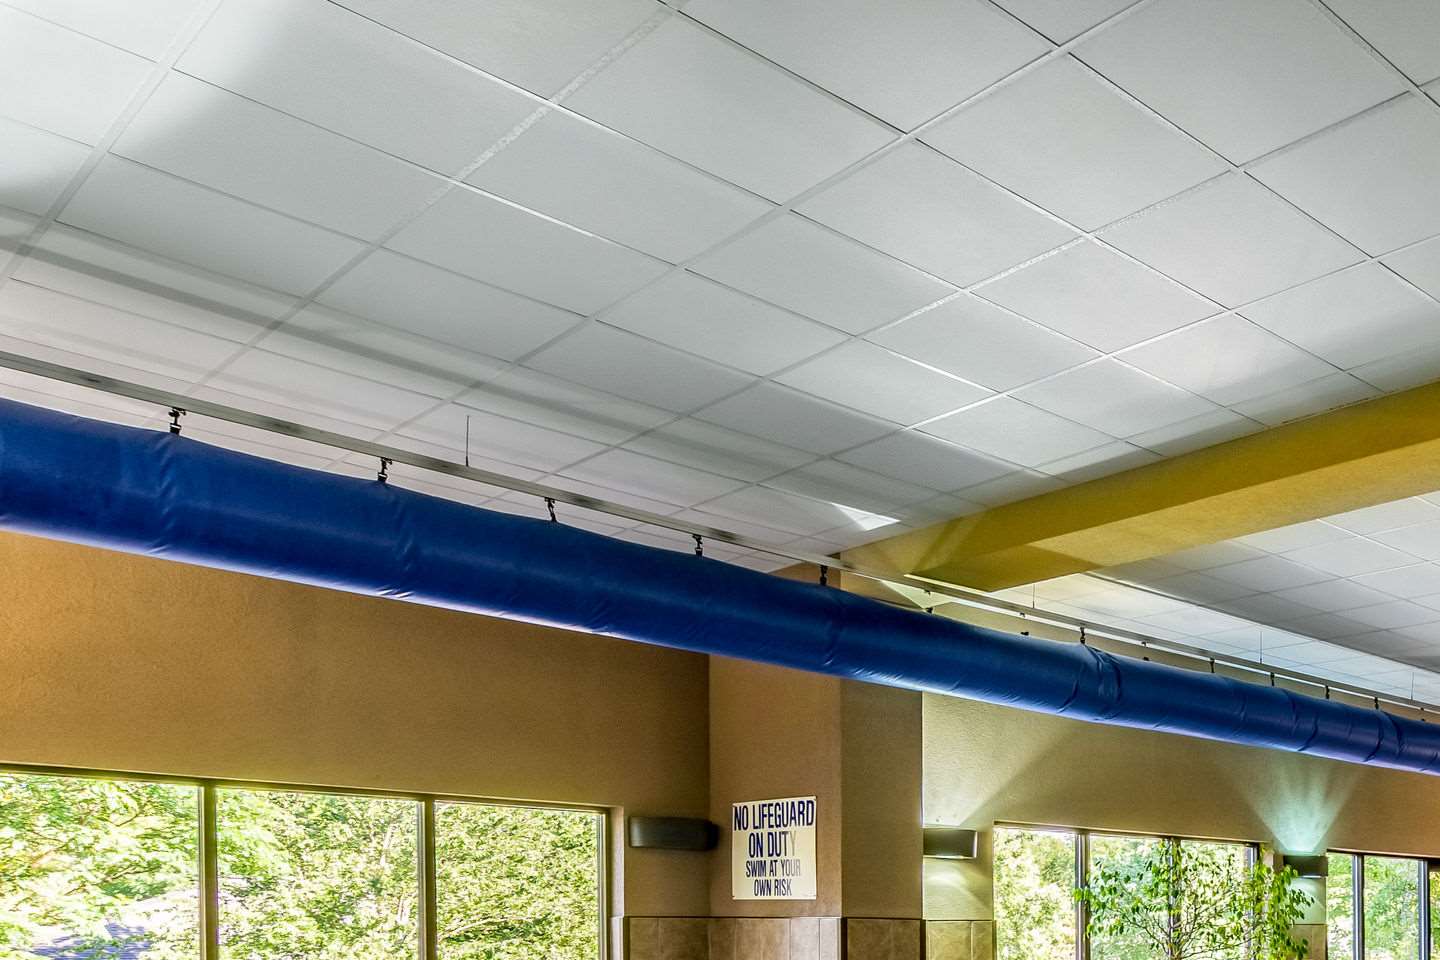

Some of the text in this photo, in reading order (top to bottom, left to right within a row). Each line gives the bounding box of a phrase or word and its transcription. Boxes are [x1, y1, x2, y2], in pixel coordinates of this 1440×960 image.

[734, 800, 815, 831] NO LIFEGUARD
[748, 830, 797, 858] ON DUTY
[746, 859, 801, 878] SWIM AT YOUR
[754, 879, 793, 896] OWN RISK
